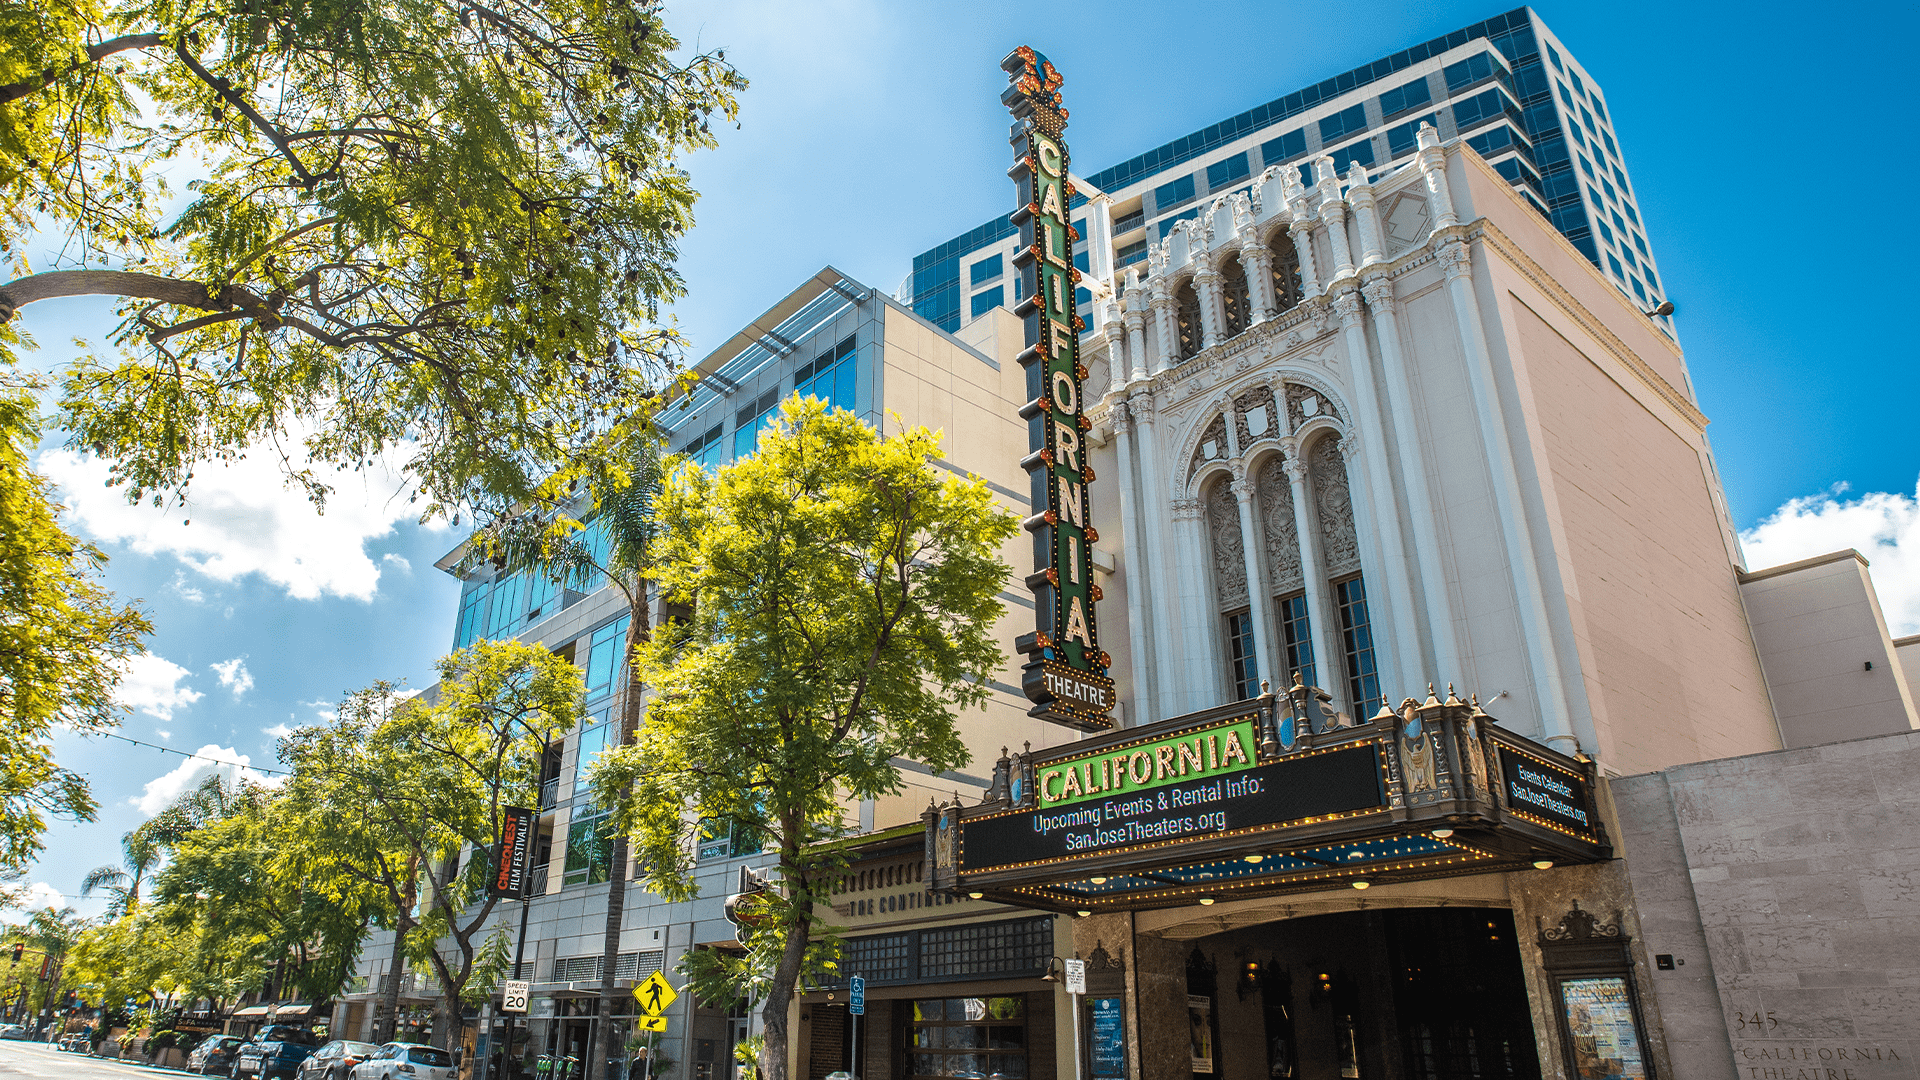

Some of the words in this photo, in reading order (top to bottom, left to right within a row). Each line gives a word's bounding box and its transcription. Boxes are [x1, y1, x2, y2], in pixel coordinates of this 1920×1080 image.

[1038, 139, 1092, 649] CALIFORNIA
[1045, 672, 1107, 708] THEATRE
[1041, 730, 1248, 803] CALIFORNIA
[1517, 764, 1542, 787] Events
[1033, 807, 1101, 836] Upcoming
[1104, 797, 1153, 821] Events
[1157, 791, 1168, 811] &
[1171, 780, 1222, 808] Rental
[1226, 775, 1265, 799] Info:
[1511, 781, 1589, 827] SanJoseTheaters.org
[1066, 811, 1226, 851] SanJoseTheaters.org
[497, 814, 517, 890] CINEQUEST
[509, 868, 521, 891] FILM
[850, 899, 873, 917] THE
[507, 982, 527, 990] SPEED
[505, 996, 525, 1008] 20
[1734, 1011, 1778, 1031] 345
[1743, 1047, 1901, 1061] CALIFORNIA
[1746, 1067, 1857, 1080] THEATRE
